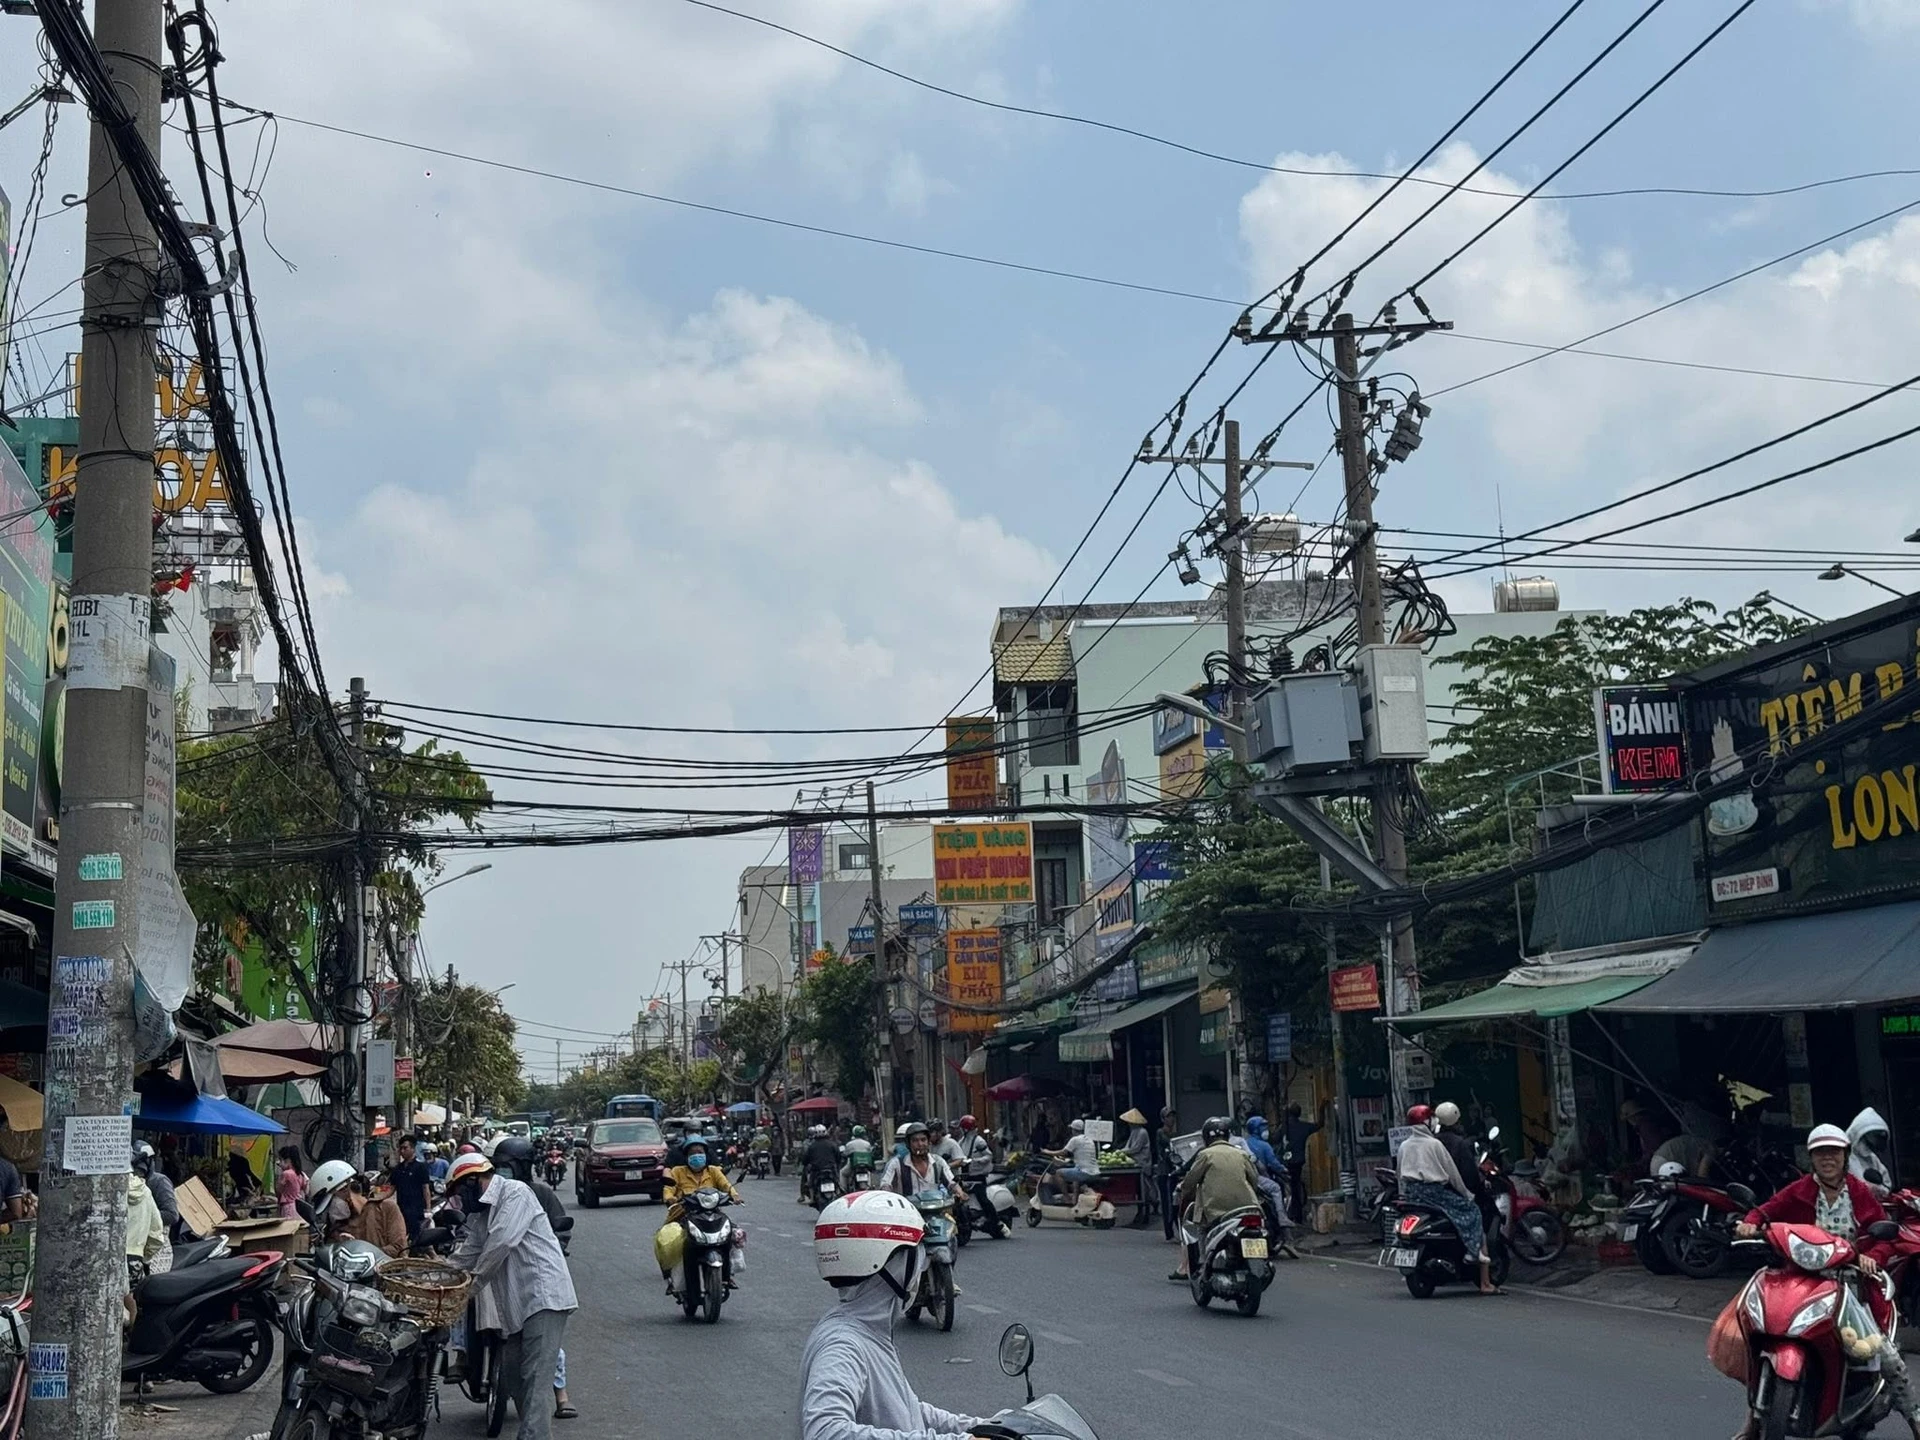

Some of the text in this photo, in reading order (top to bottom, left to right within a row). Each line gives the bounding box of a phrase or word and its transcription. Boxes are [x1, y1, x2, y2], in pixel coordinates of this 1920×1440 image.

[1609, 696, 1680, 736] BÁNH
[1760, 662, 1863, 775] TIỆM
[1618, 747, 1680, 780] KEM
[954, 771, 990, 789] PHÁT
[1825, 765, 1920, 850] LON
[937, 827, 1026, 851] TIỆM VÀNG
[959, 851, 987, 879] PHÁT
[901, 909, 933, 920] NHÀ SÁCH
[963, 966, 987, 980] KIM
